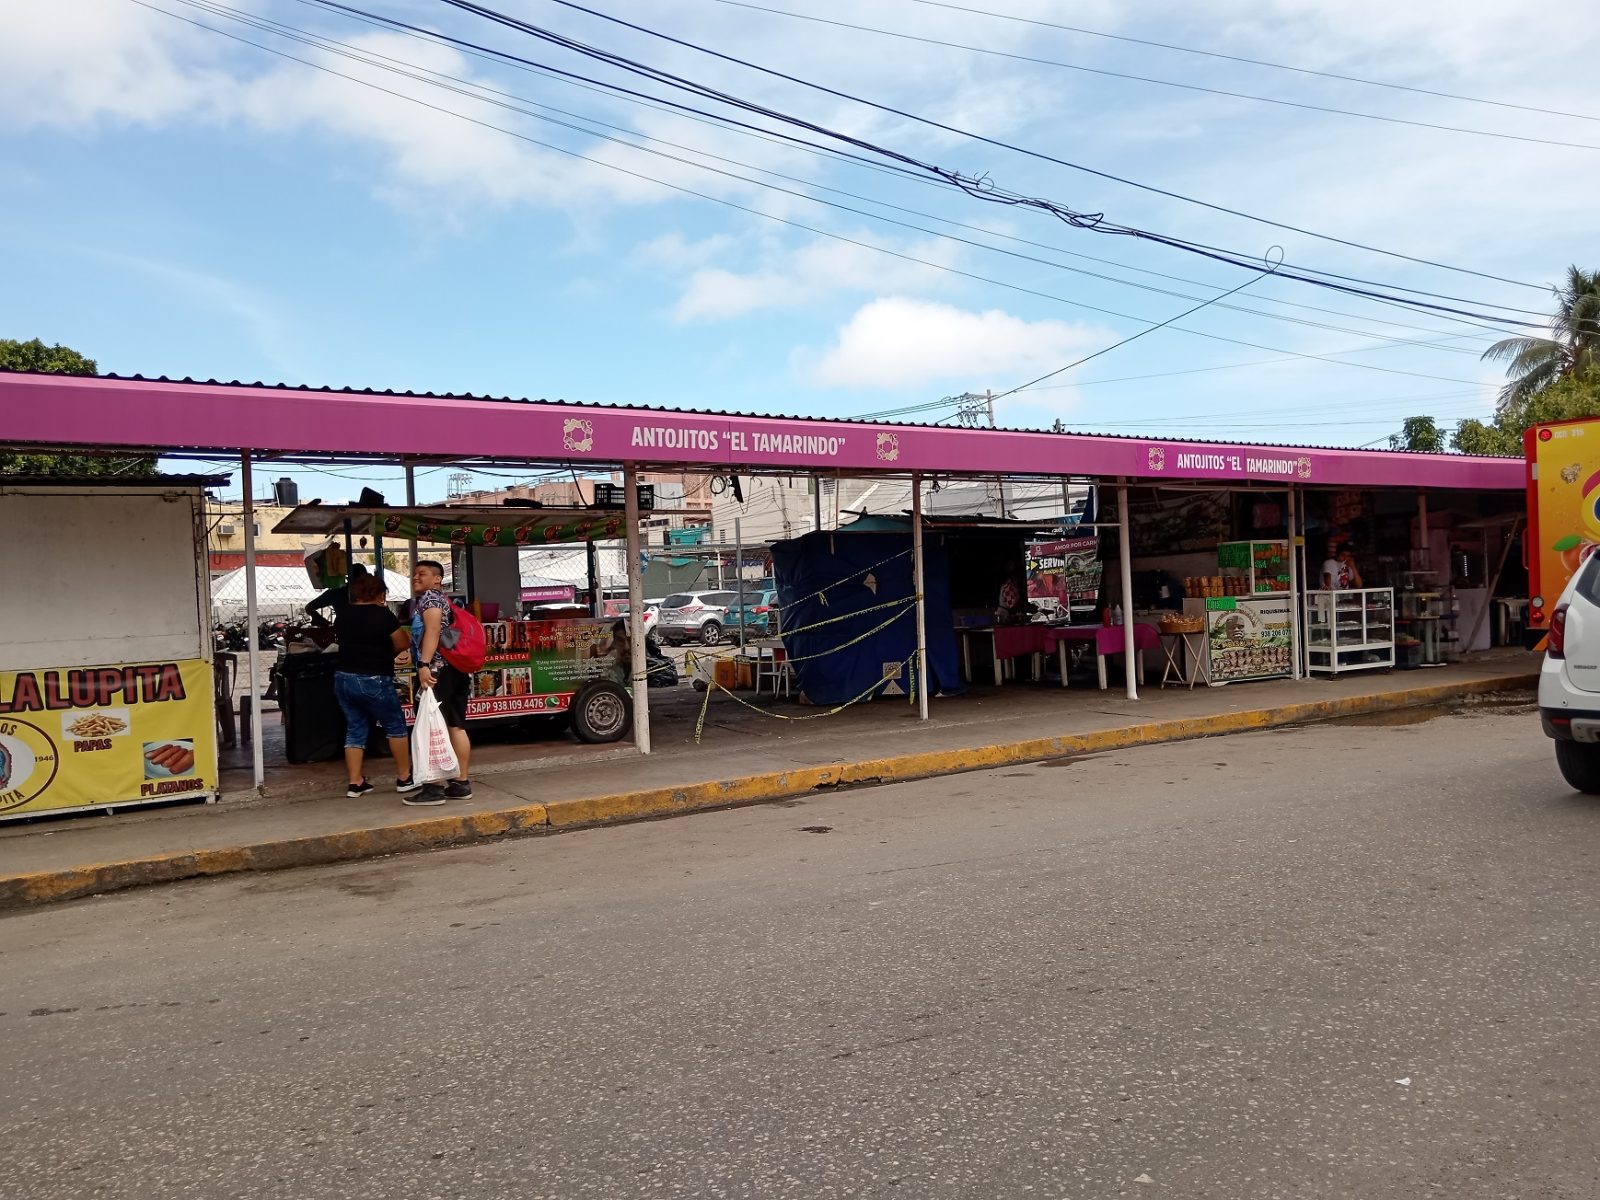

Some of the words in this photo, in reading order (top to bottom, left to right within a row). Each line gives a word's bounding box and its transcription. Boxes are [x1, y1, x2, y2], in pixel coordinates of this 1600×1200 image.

[631, 426, 718, 450] ANTOJITOS
[1177, 453, 1225, 470] ANTOJITOS
[493, 698, 543, 711] 938.109.4476
[74, 738, 112, 753] PAPAS
[34, 755, 54, 763] 1946
[141, 778, 204, 796] PLATANOS
